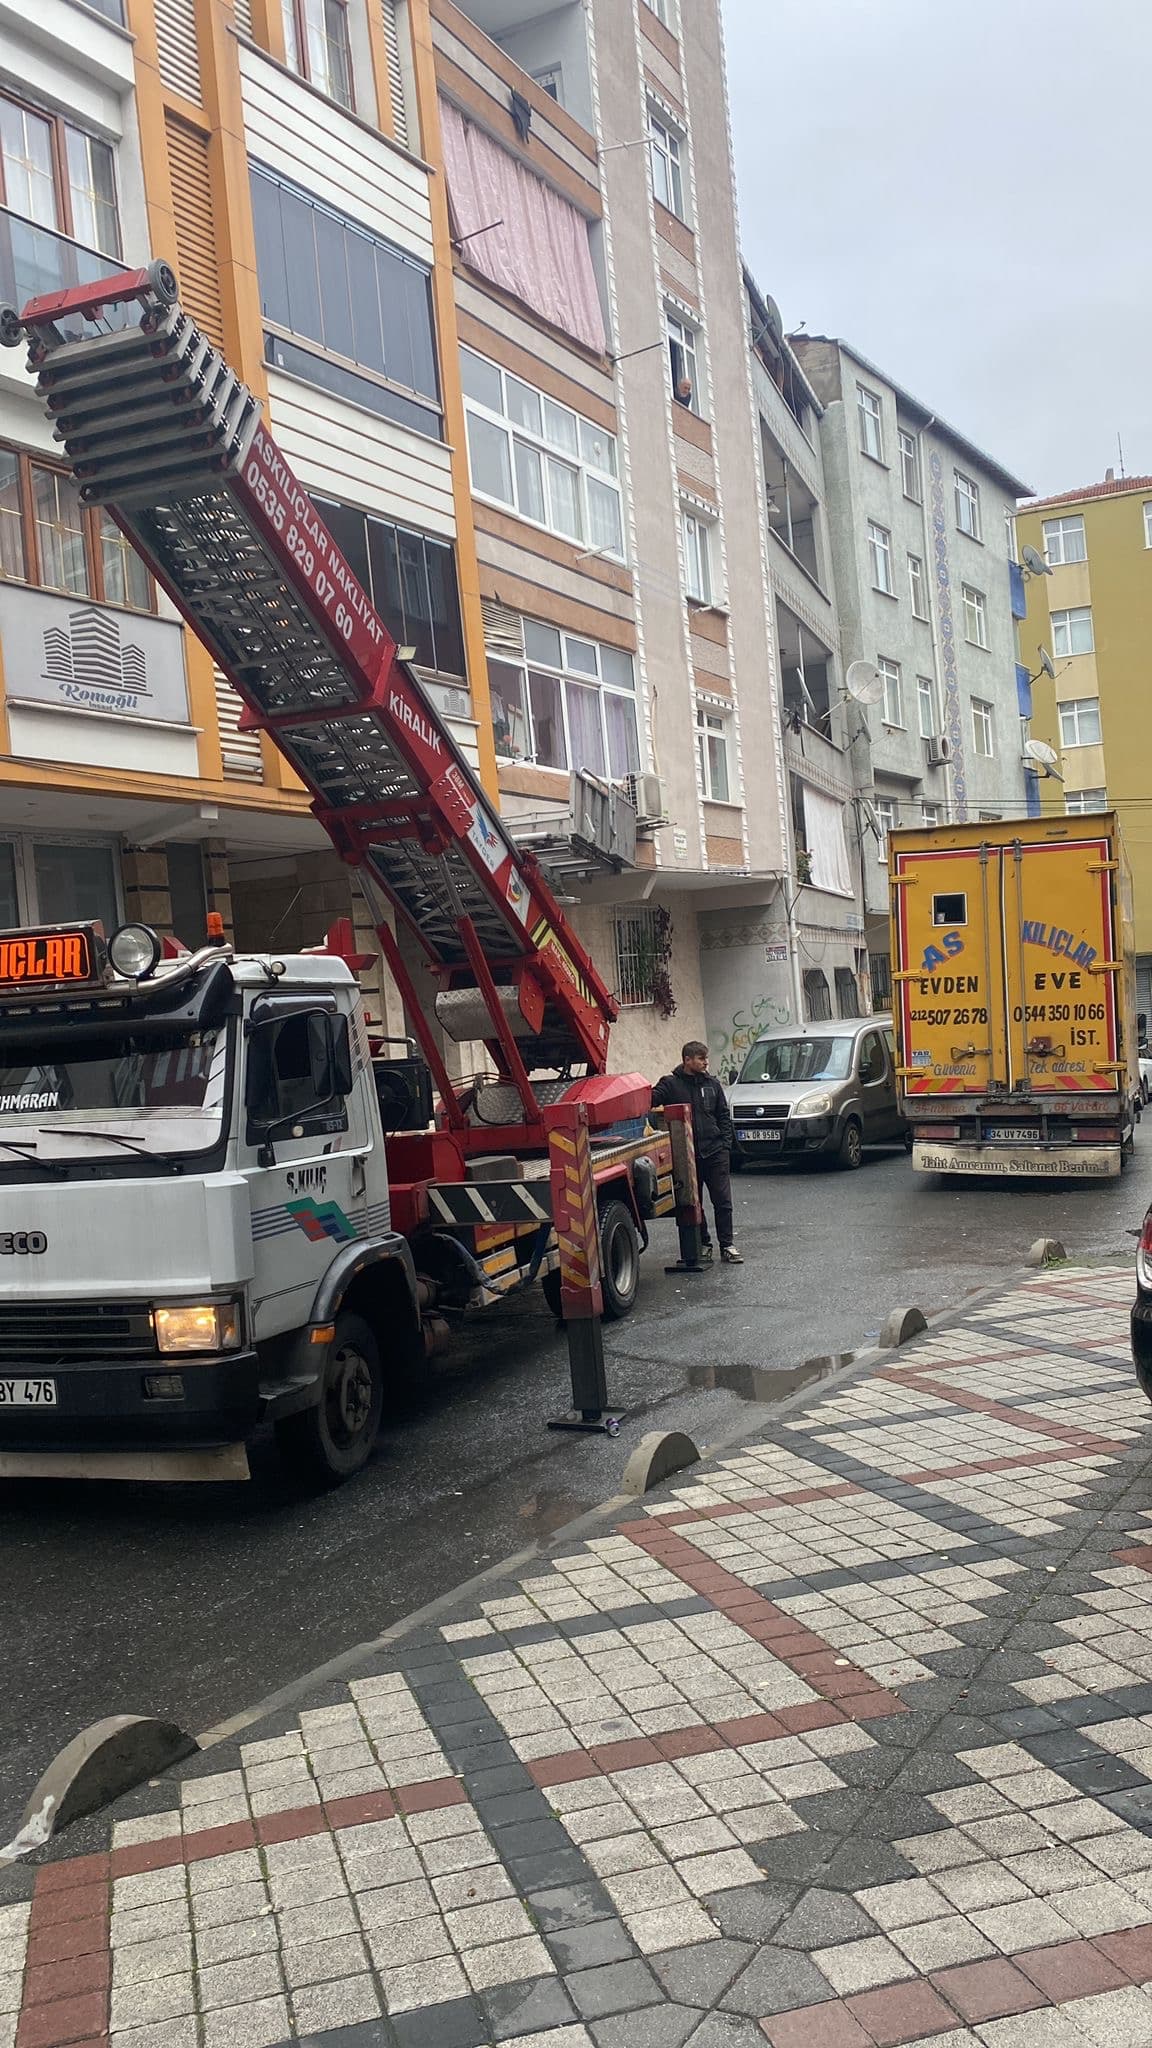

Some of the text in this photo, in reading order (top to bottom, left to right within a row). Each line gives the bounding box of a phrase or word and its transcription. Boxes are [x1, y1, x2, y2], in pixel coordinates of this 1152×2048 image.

[247, 461, 354, 640] 0535 829 07 60
[328, 551, 384, 645] NAKLİYAT
[390, 690, 441, 755] KİRALIK
[922, 920, 1097, 973] AS KILIÇLAR
[920, 972, 1081, 995] EVDEN EVE
[1048, 1004, 1070, 1021] 350
[1074, 1004, 1086, 1021] 10
[1088, 1003, 1105, 1020] 66
[1071, 1027, 1101, 1046] İST.
[990, 1130, 1001, 1139] 34
[921, 1156, 947, 1169] Taht
[1009, 1160, 1058, 1173] Saltanat
[24, 1381, 53, 1402] 476
